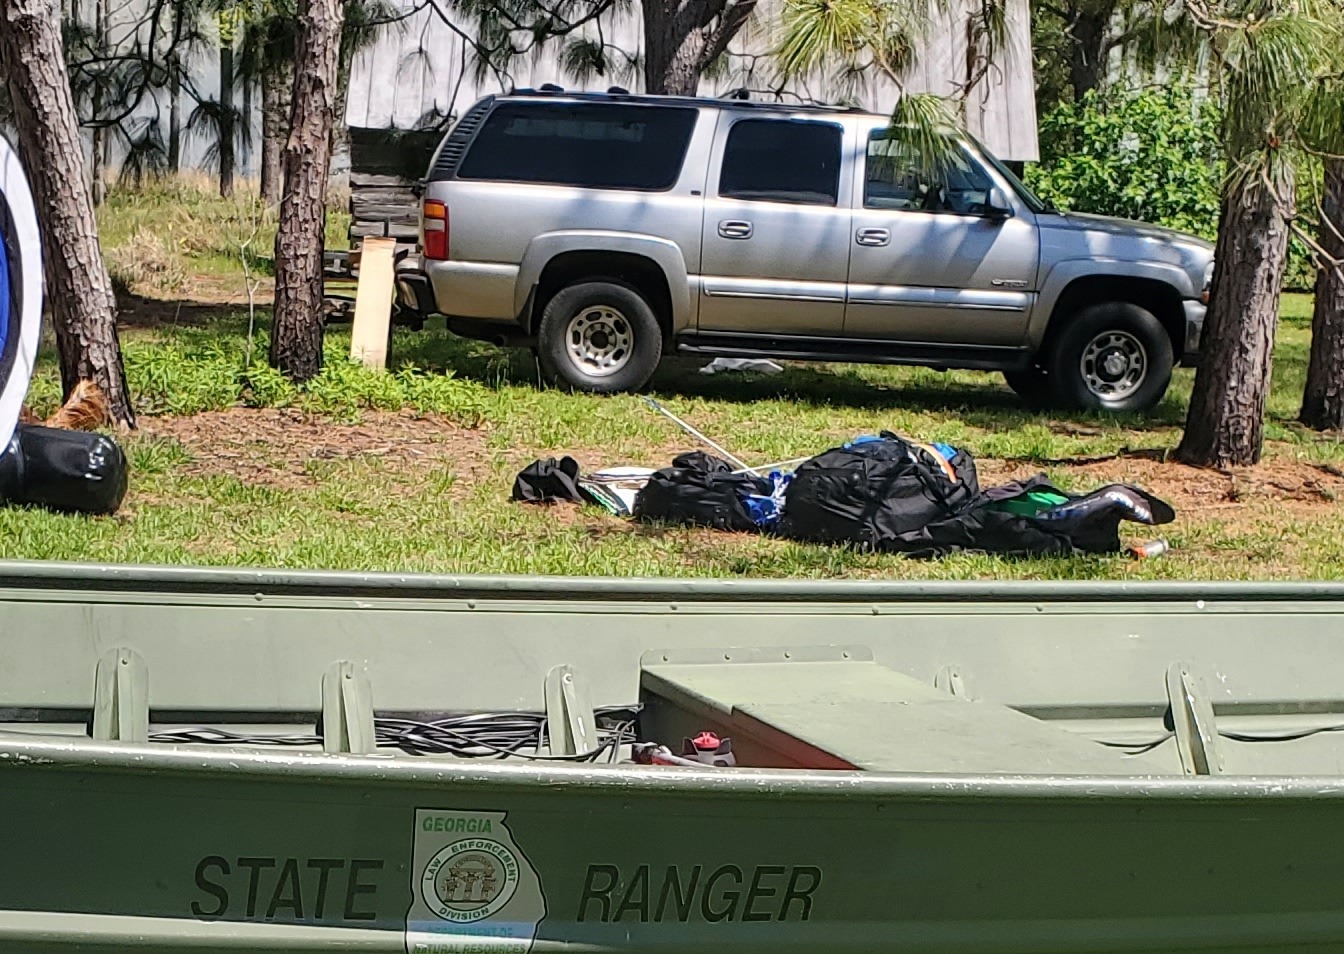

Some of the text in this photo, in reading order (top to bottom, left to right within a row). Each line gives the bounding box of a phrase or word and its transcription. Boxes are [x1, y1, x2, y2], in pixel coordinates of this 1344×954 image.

[422, 816, 493, 833] GEORGIA
[425, 840, 516, 883] LAW ENFORCEMENT
[190, 856, 823, 923] STATE RANGER
[439, 907, 489, 920] DIVISION
[411, 943, 526, 954] NATURAL RESOURCES
